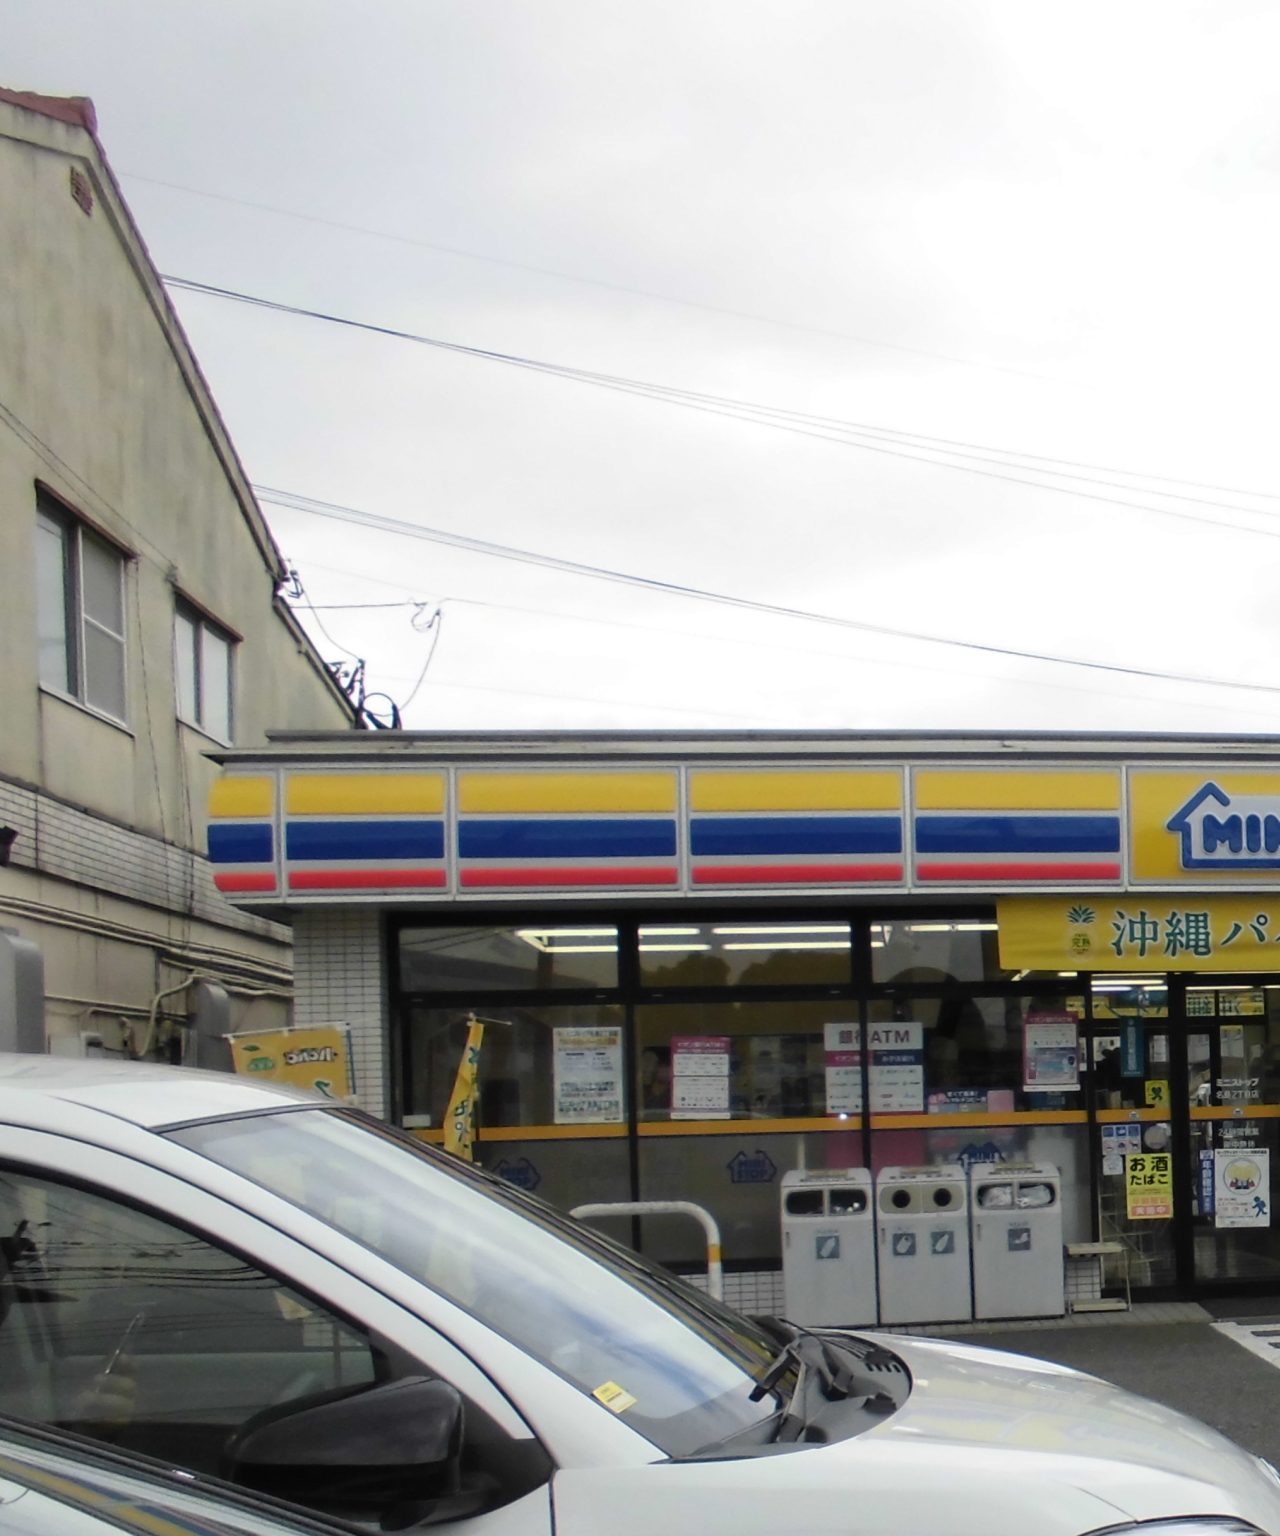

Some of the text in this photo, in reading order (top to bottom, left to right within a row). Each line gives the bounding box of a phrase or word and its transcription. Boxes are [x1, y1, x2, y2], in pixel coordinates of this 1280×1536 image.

[838, 1029, 910, 1045] 銀ATM
[1129, 1156, 1169, 1172] お酒
[1129, 1173, 1169, 1186] たばこ
